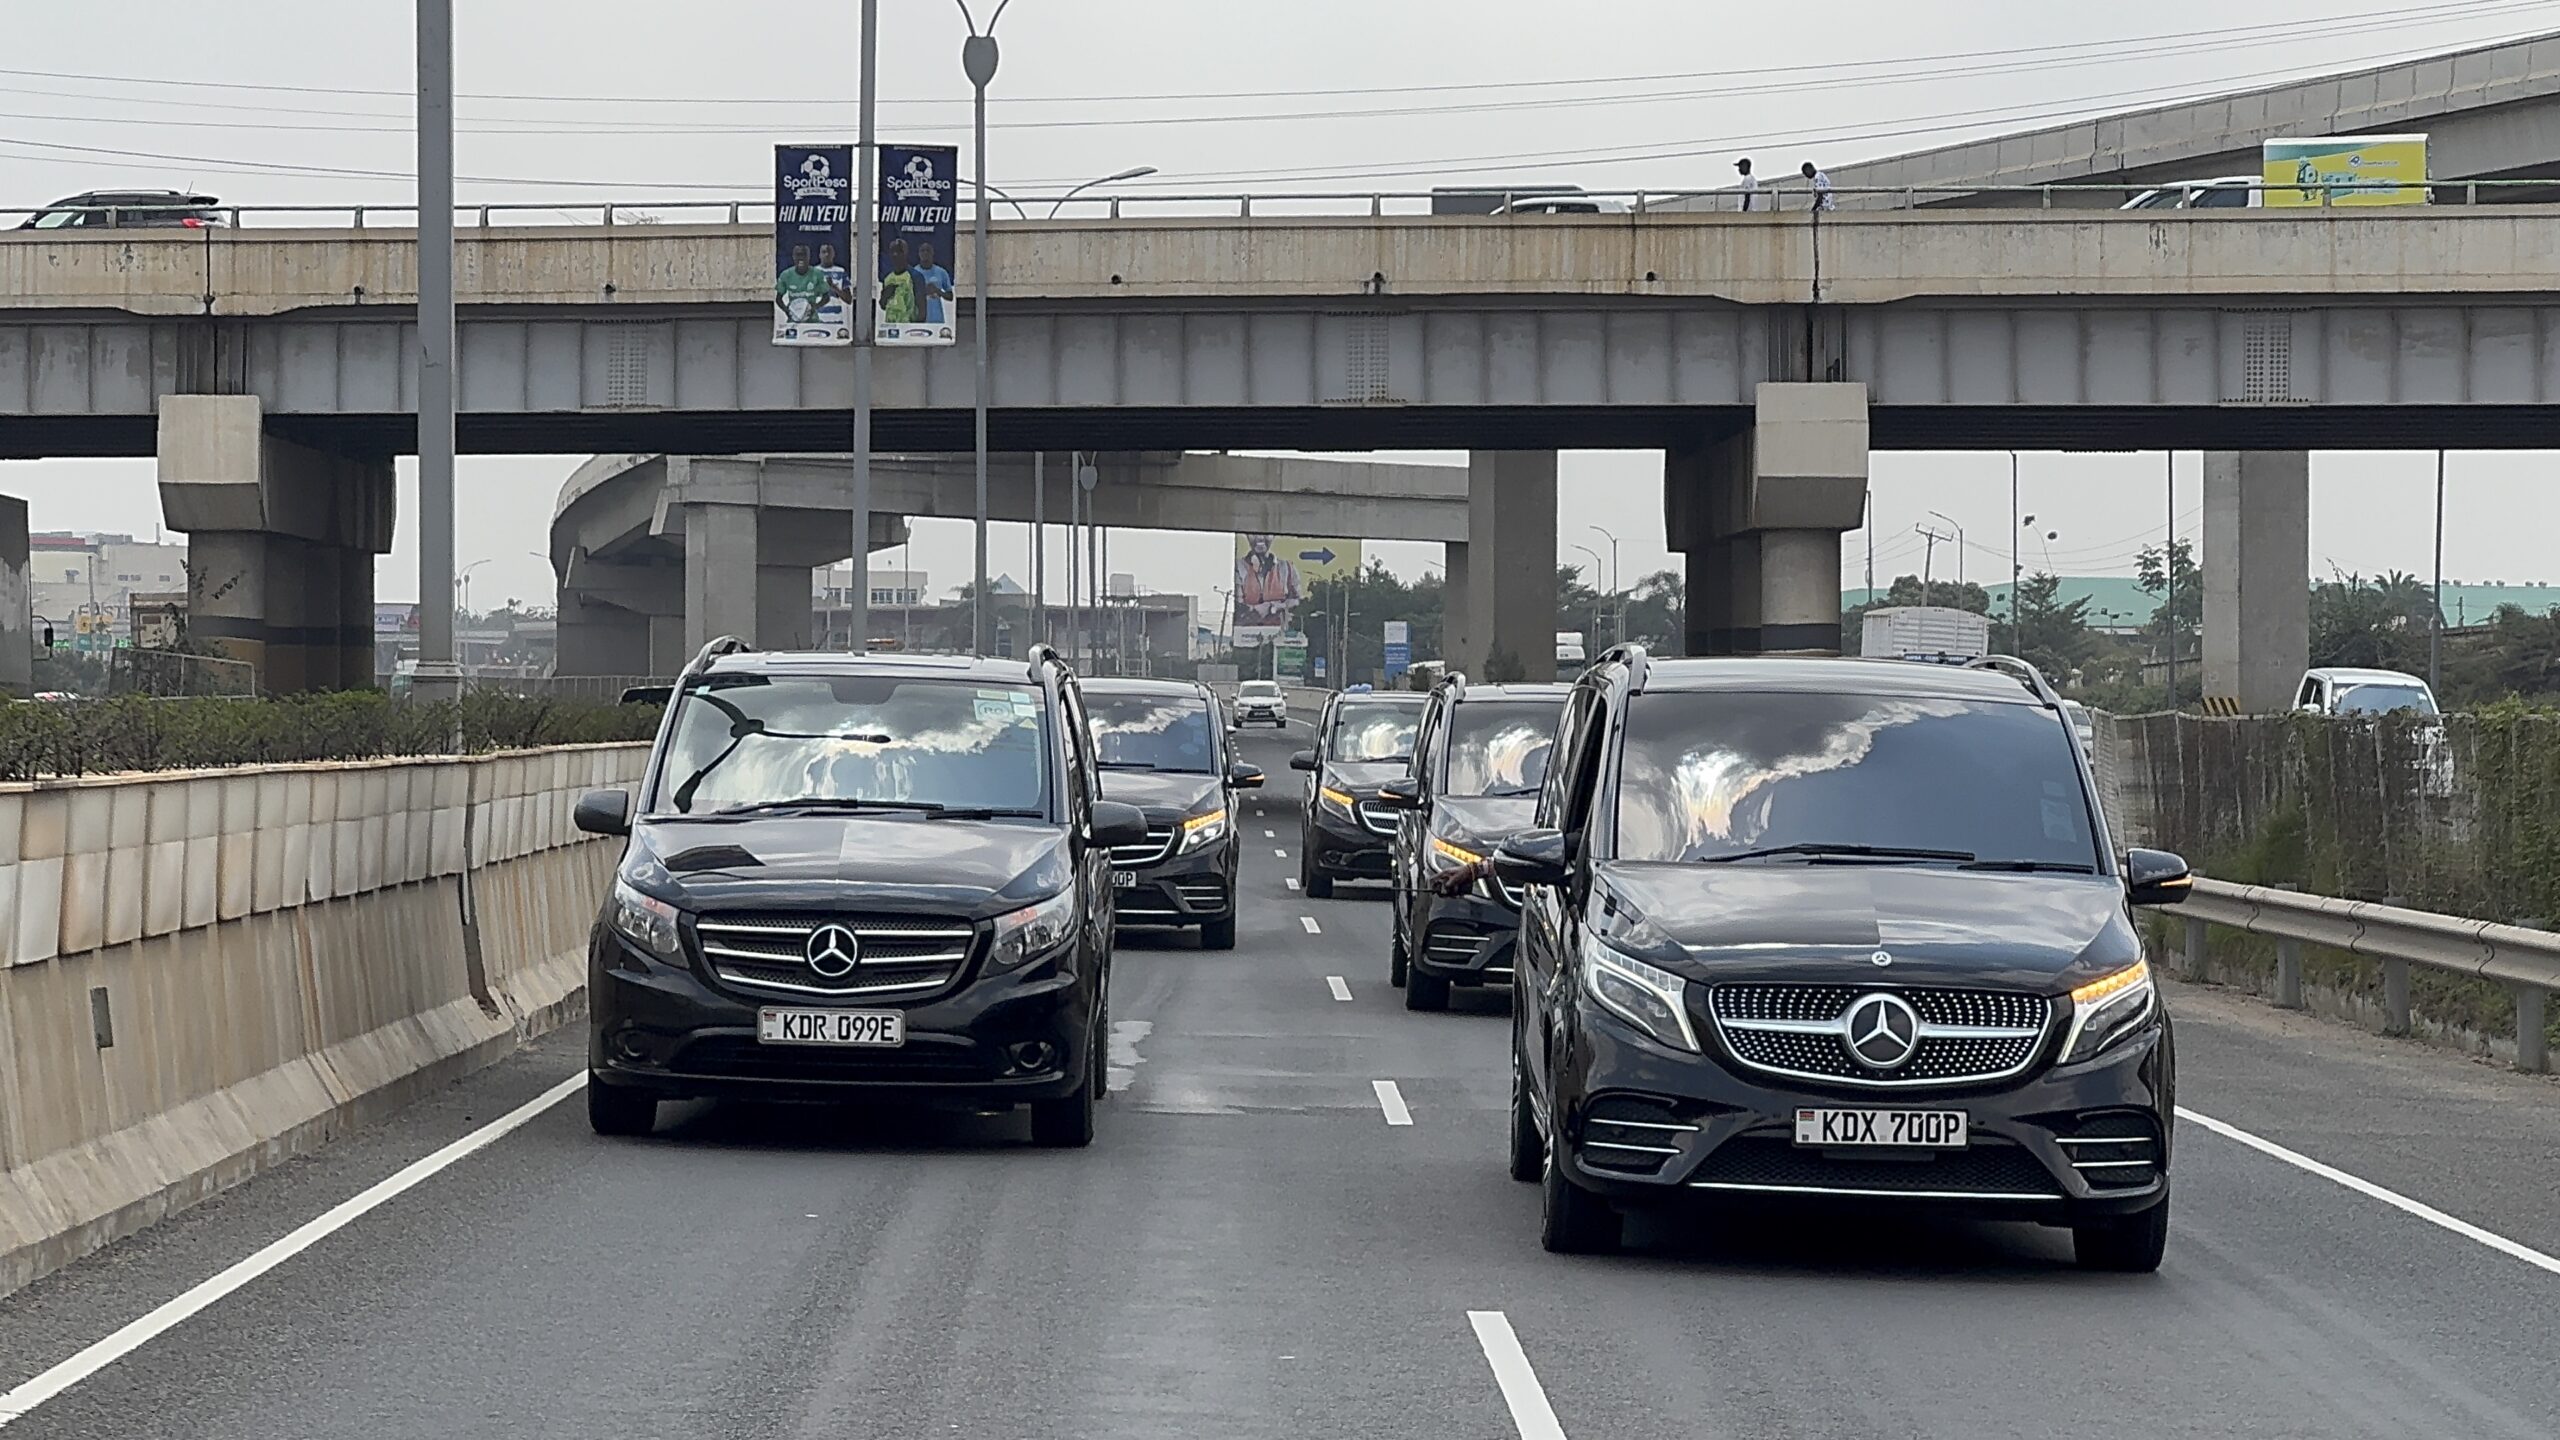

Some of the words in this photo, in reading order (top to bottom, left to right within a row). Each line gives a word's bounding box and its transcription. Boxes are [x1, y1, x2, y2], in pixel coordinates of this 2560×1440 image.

[783, 174, 848, 190] SportPesa
[886, 175, 951, 191] SportPesa
[778, 205, 798, 223] HII
[799, 206, 814, 222] NI
[817, 206, 849, 222] YETU
[881, 206, 901, 223] HII
[901, 206, 917, 223] NI
[919, 206, 952, 223] YETU
[783, 1013, 827, 1040] KDR
[837, 1015, 895, 1041] 099E
[1822, 1111, 1877, 1142] KDX
[1889, 1112, 1961, 1143] 700P
